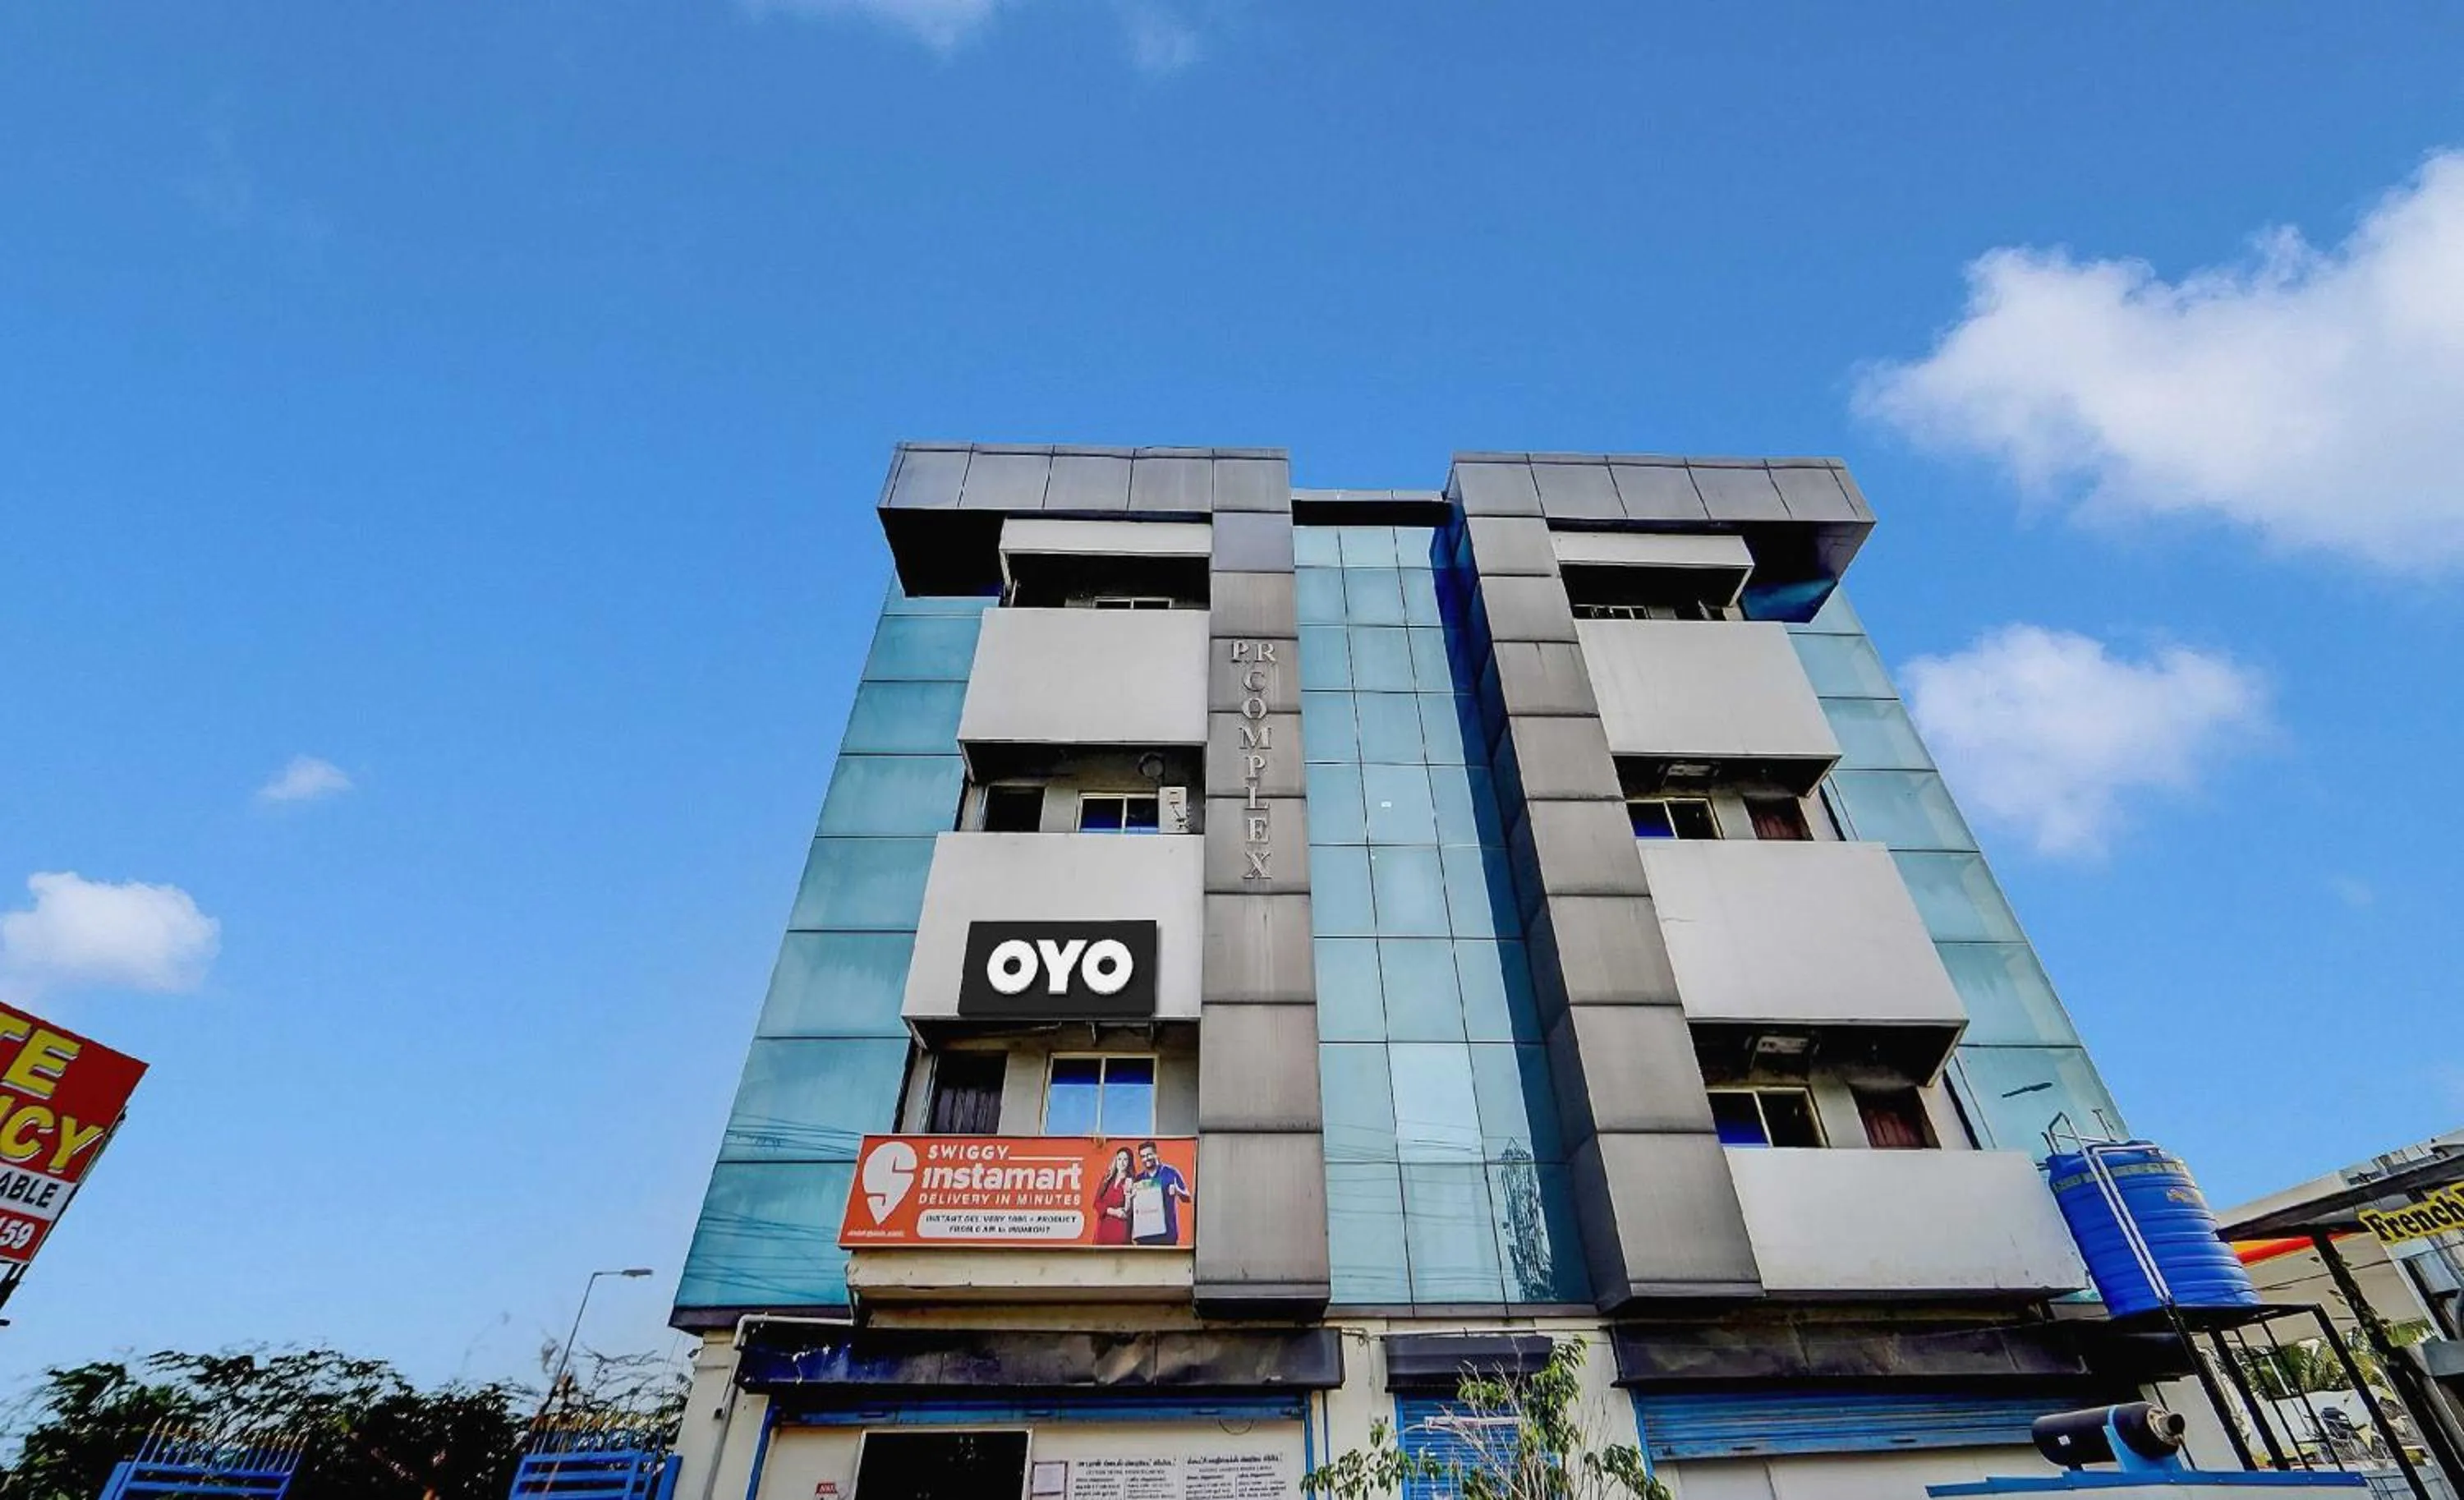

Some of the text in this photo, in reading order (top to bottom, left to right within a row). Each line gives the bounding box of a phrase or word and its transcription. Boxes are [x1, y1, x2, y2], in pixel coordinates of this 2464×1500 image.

[1239, 671, 1273, 880] COMPLEX
[986, 939, 1134, 995] OYO
[927, 1144, 1009, 1161] SWIGGY
[922, 1162, 1083, 1190] instamart
[918, 1194, 1081, 1205] DELIVERY IN MINUTES
[0, 1216, 34, 1249] 59
[2363, 1194, 2464, 1242] French
